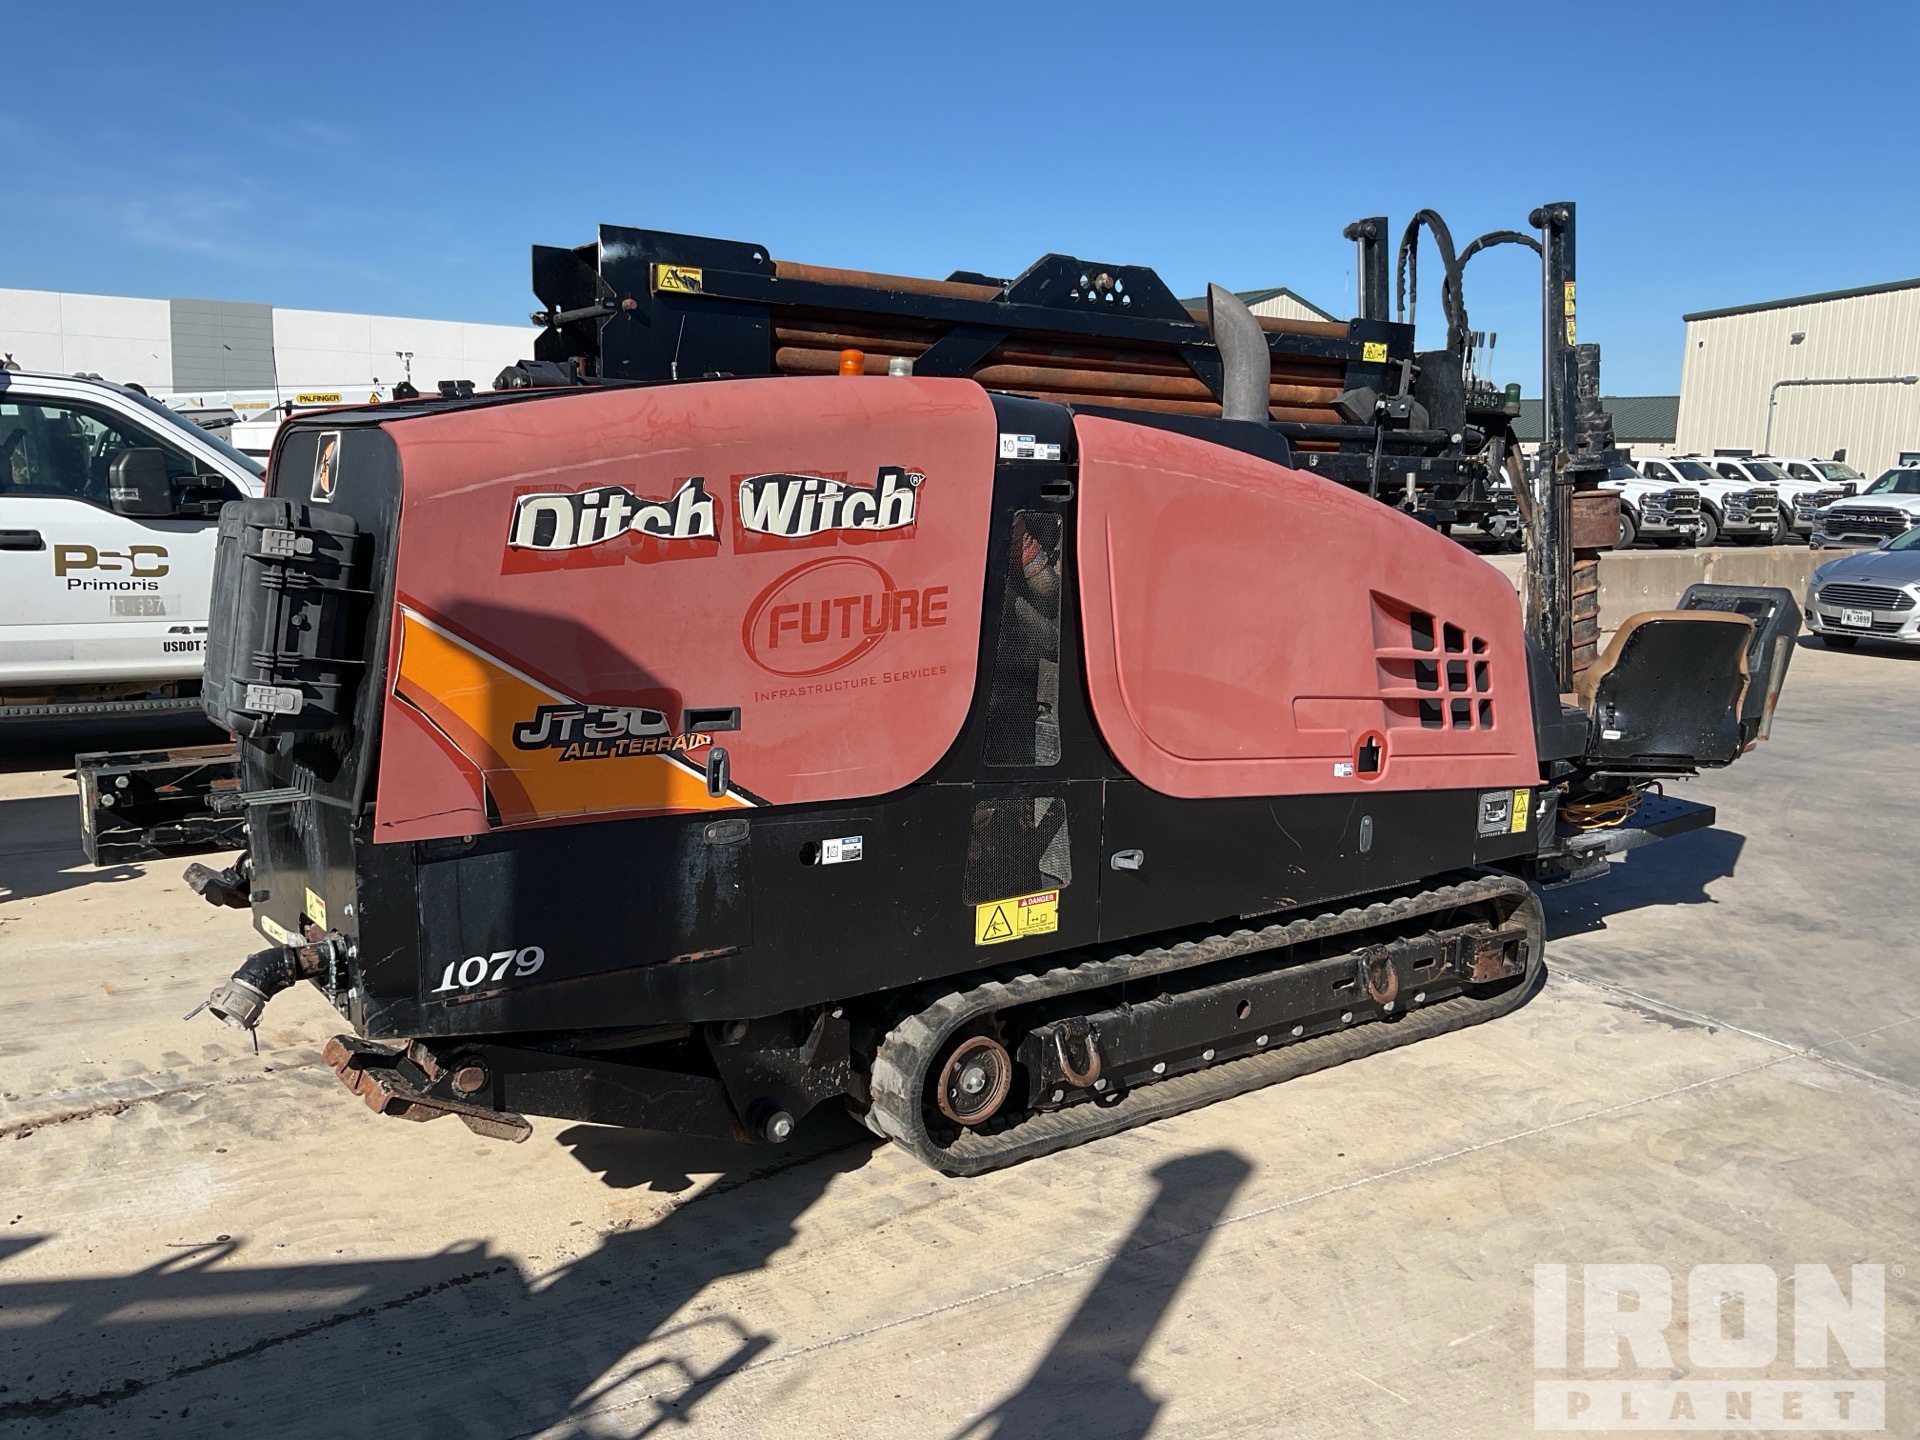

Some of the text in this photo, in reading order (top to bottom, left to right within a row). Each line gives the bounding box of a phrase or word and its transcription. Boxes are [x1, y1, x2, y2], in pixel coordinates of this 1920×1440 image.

[300, 394, 340, 402] PALFINGER
[516, 486, 715, 547] Ditch
[54, 544, 170, 577] PSC
[68, 578, 159, 591] Primoris
[768, 586, 949, 649] FUTURE
[163, 640, 202, 653] USDOT
[563, 741, 609, 758] ALL
[1028, 894, 1054, 905] DANGER
[431, 945, 545, 992] 1079
